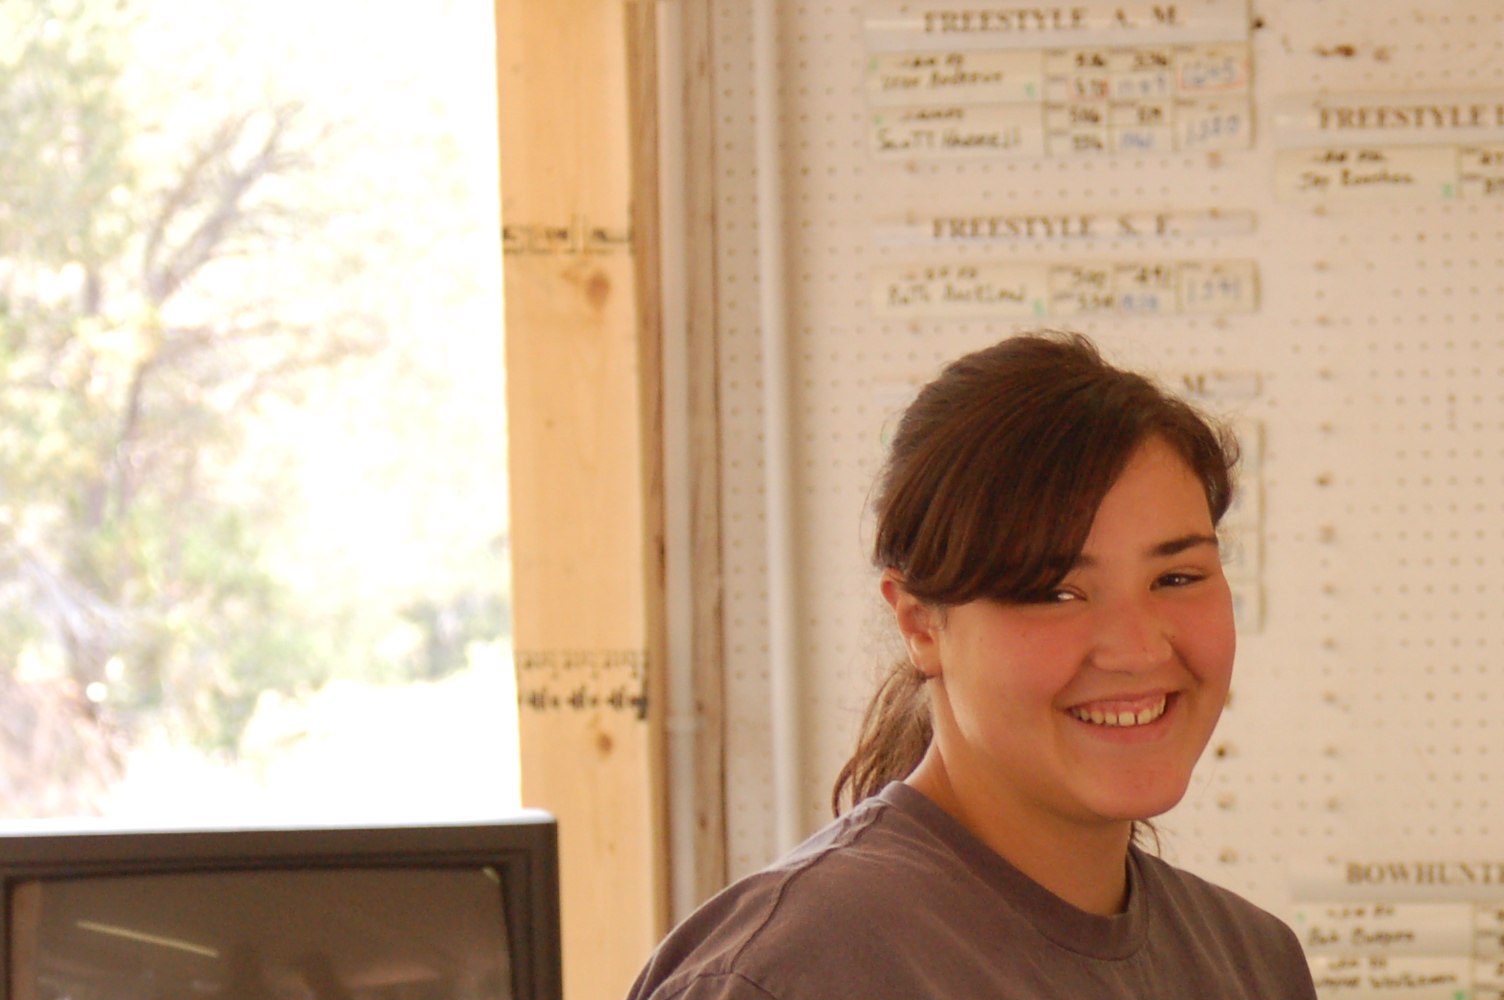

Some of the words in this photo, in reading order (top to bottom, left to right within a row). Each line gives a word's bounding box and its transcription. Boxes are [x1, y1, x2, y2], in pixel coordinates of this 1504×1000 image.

[924, 7, 1091, 33] FREESTYLE
[1318, 104, 1483, 130] FREESTYLE
[932, 214, 1095, 239] FREESTYLE
